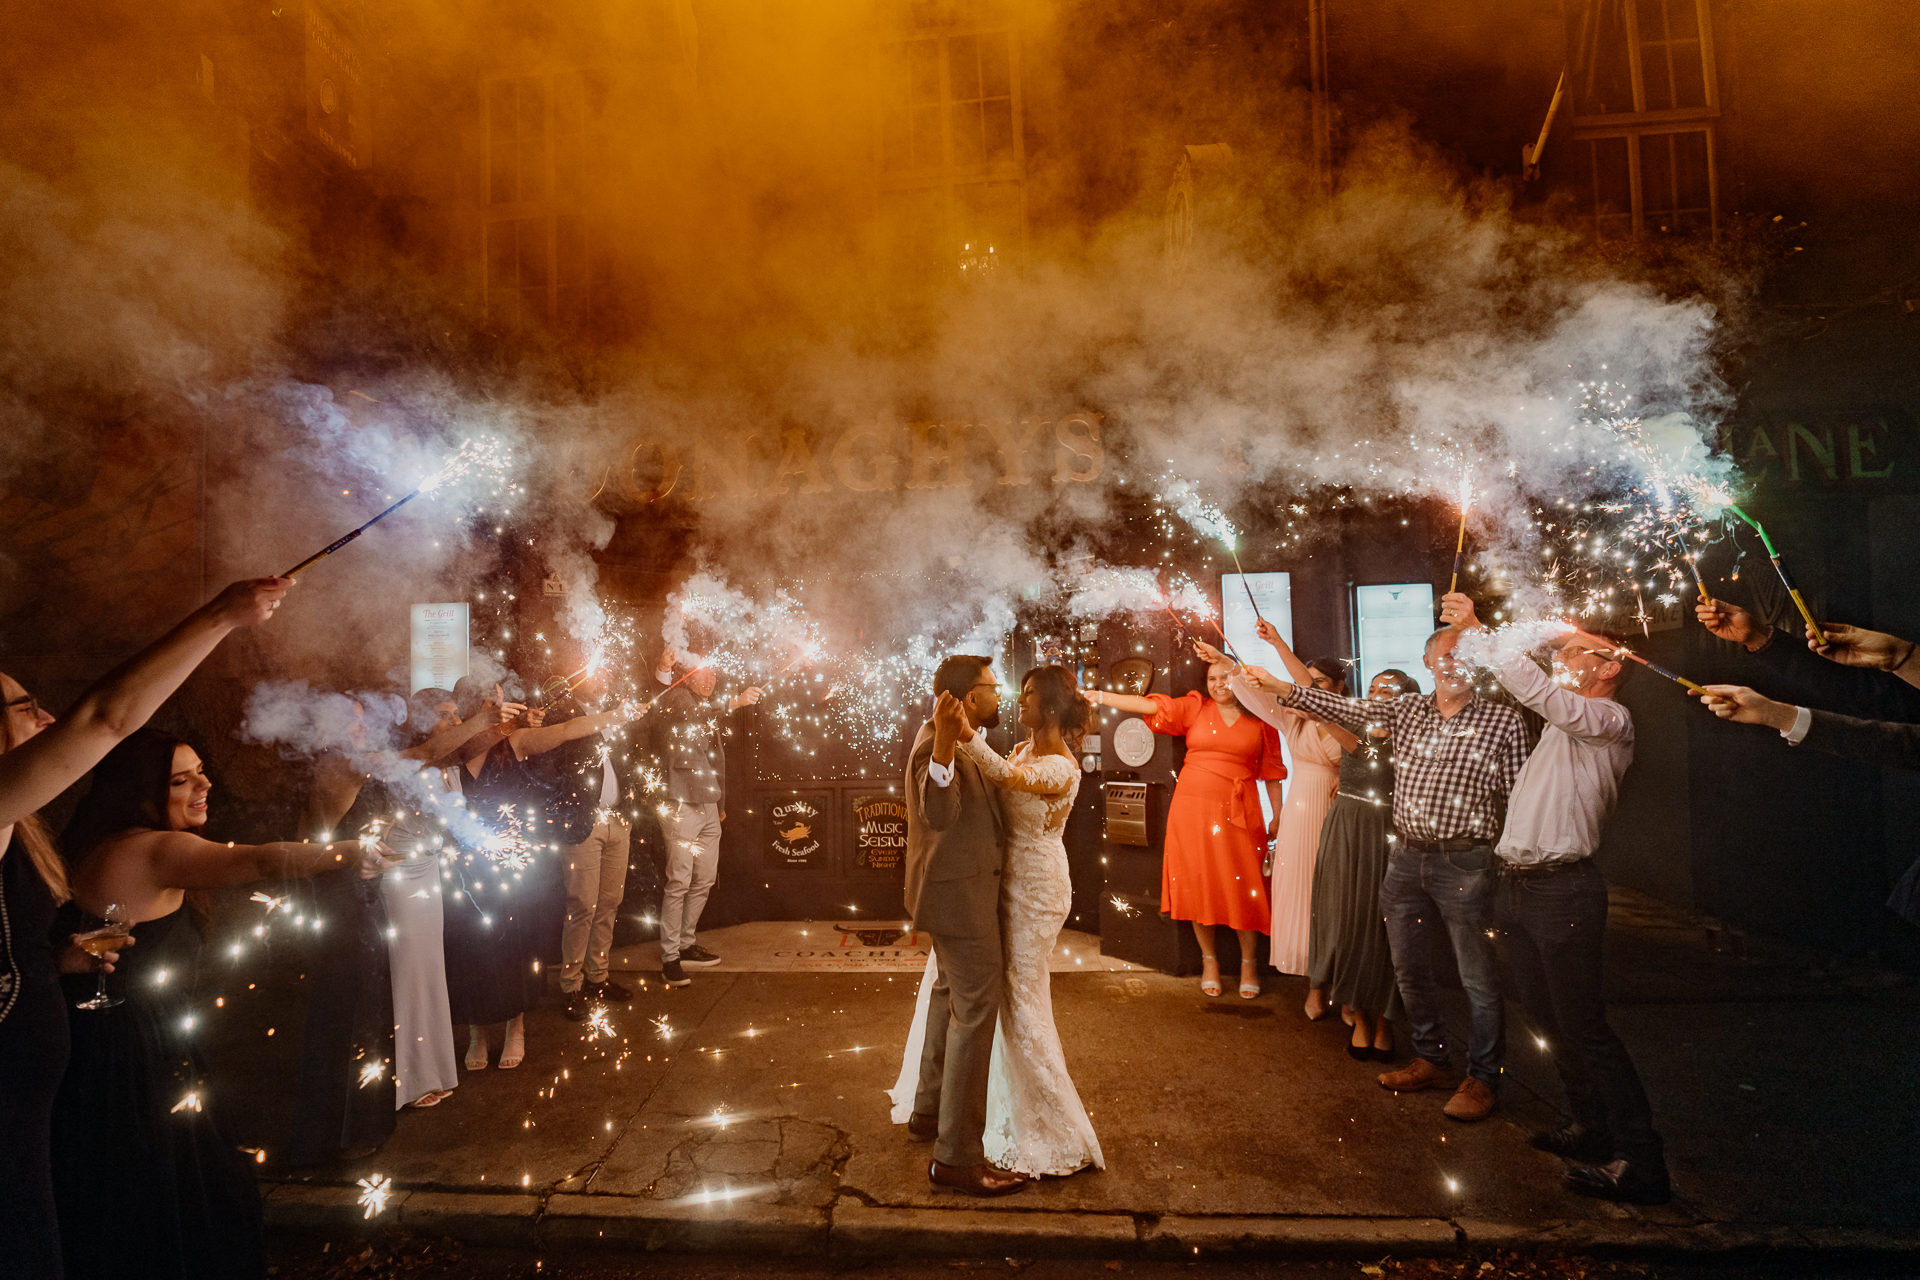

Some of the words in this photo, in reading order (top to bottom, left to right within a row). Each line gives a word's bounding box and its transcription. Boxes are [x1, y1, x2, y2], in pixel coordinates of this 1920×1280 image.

[1255, 580, 1274, 591] Grill
[422, 608, 436, 618] The
[437, 608, 455, 619] Grill
[772, 800, 819, 818] Quality
[855, 802, 908, 823] TRADITIONA
[771, 839, 791, 856] Fresh
[791, 839, 820, 857] Seafood
[773, 949, 930, 957] COACHLA
